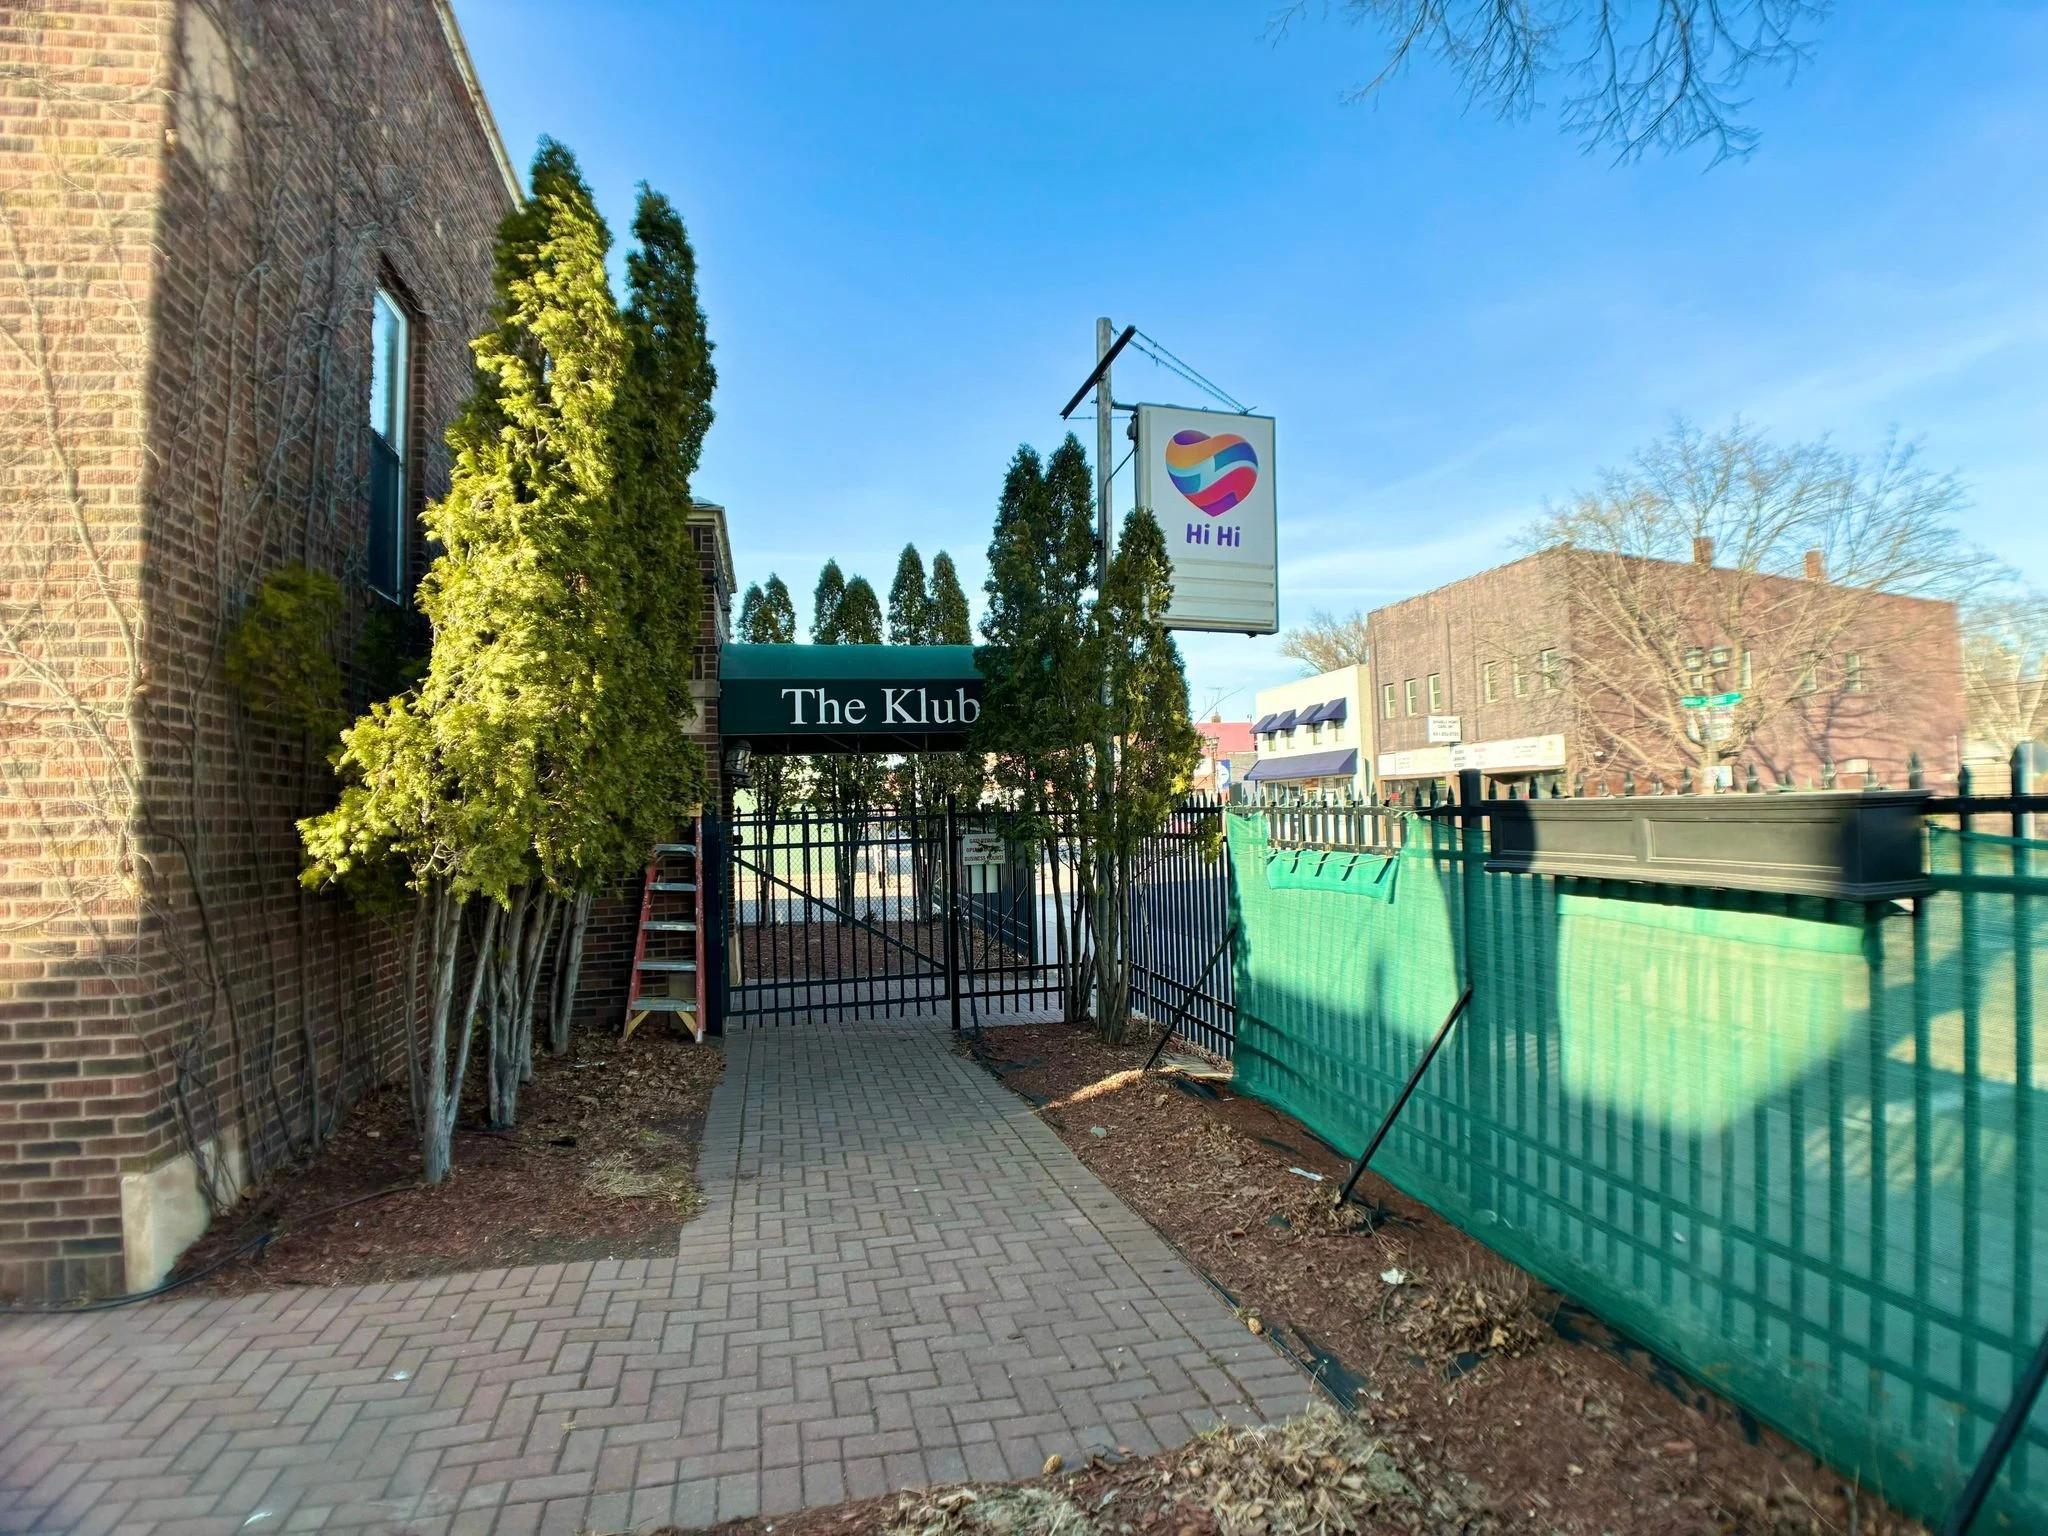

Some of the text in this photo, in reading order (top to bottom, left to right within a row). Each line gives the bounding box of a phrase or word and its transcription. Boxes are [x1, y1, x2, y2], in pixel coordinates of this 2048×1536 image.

[1185, 522, 1241, 548] Hi Hi
[781, 687, 981, 725] The Klub
